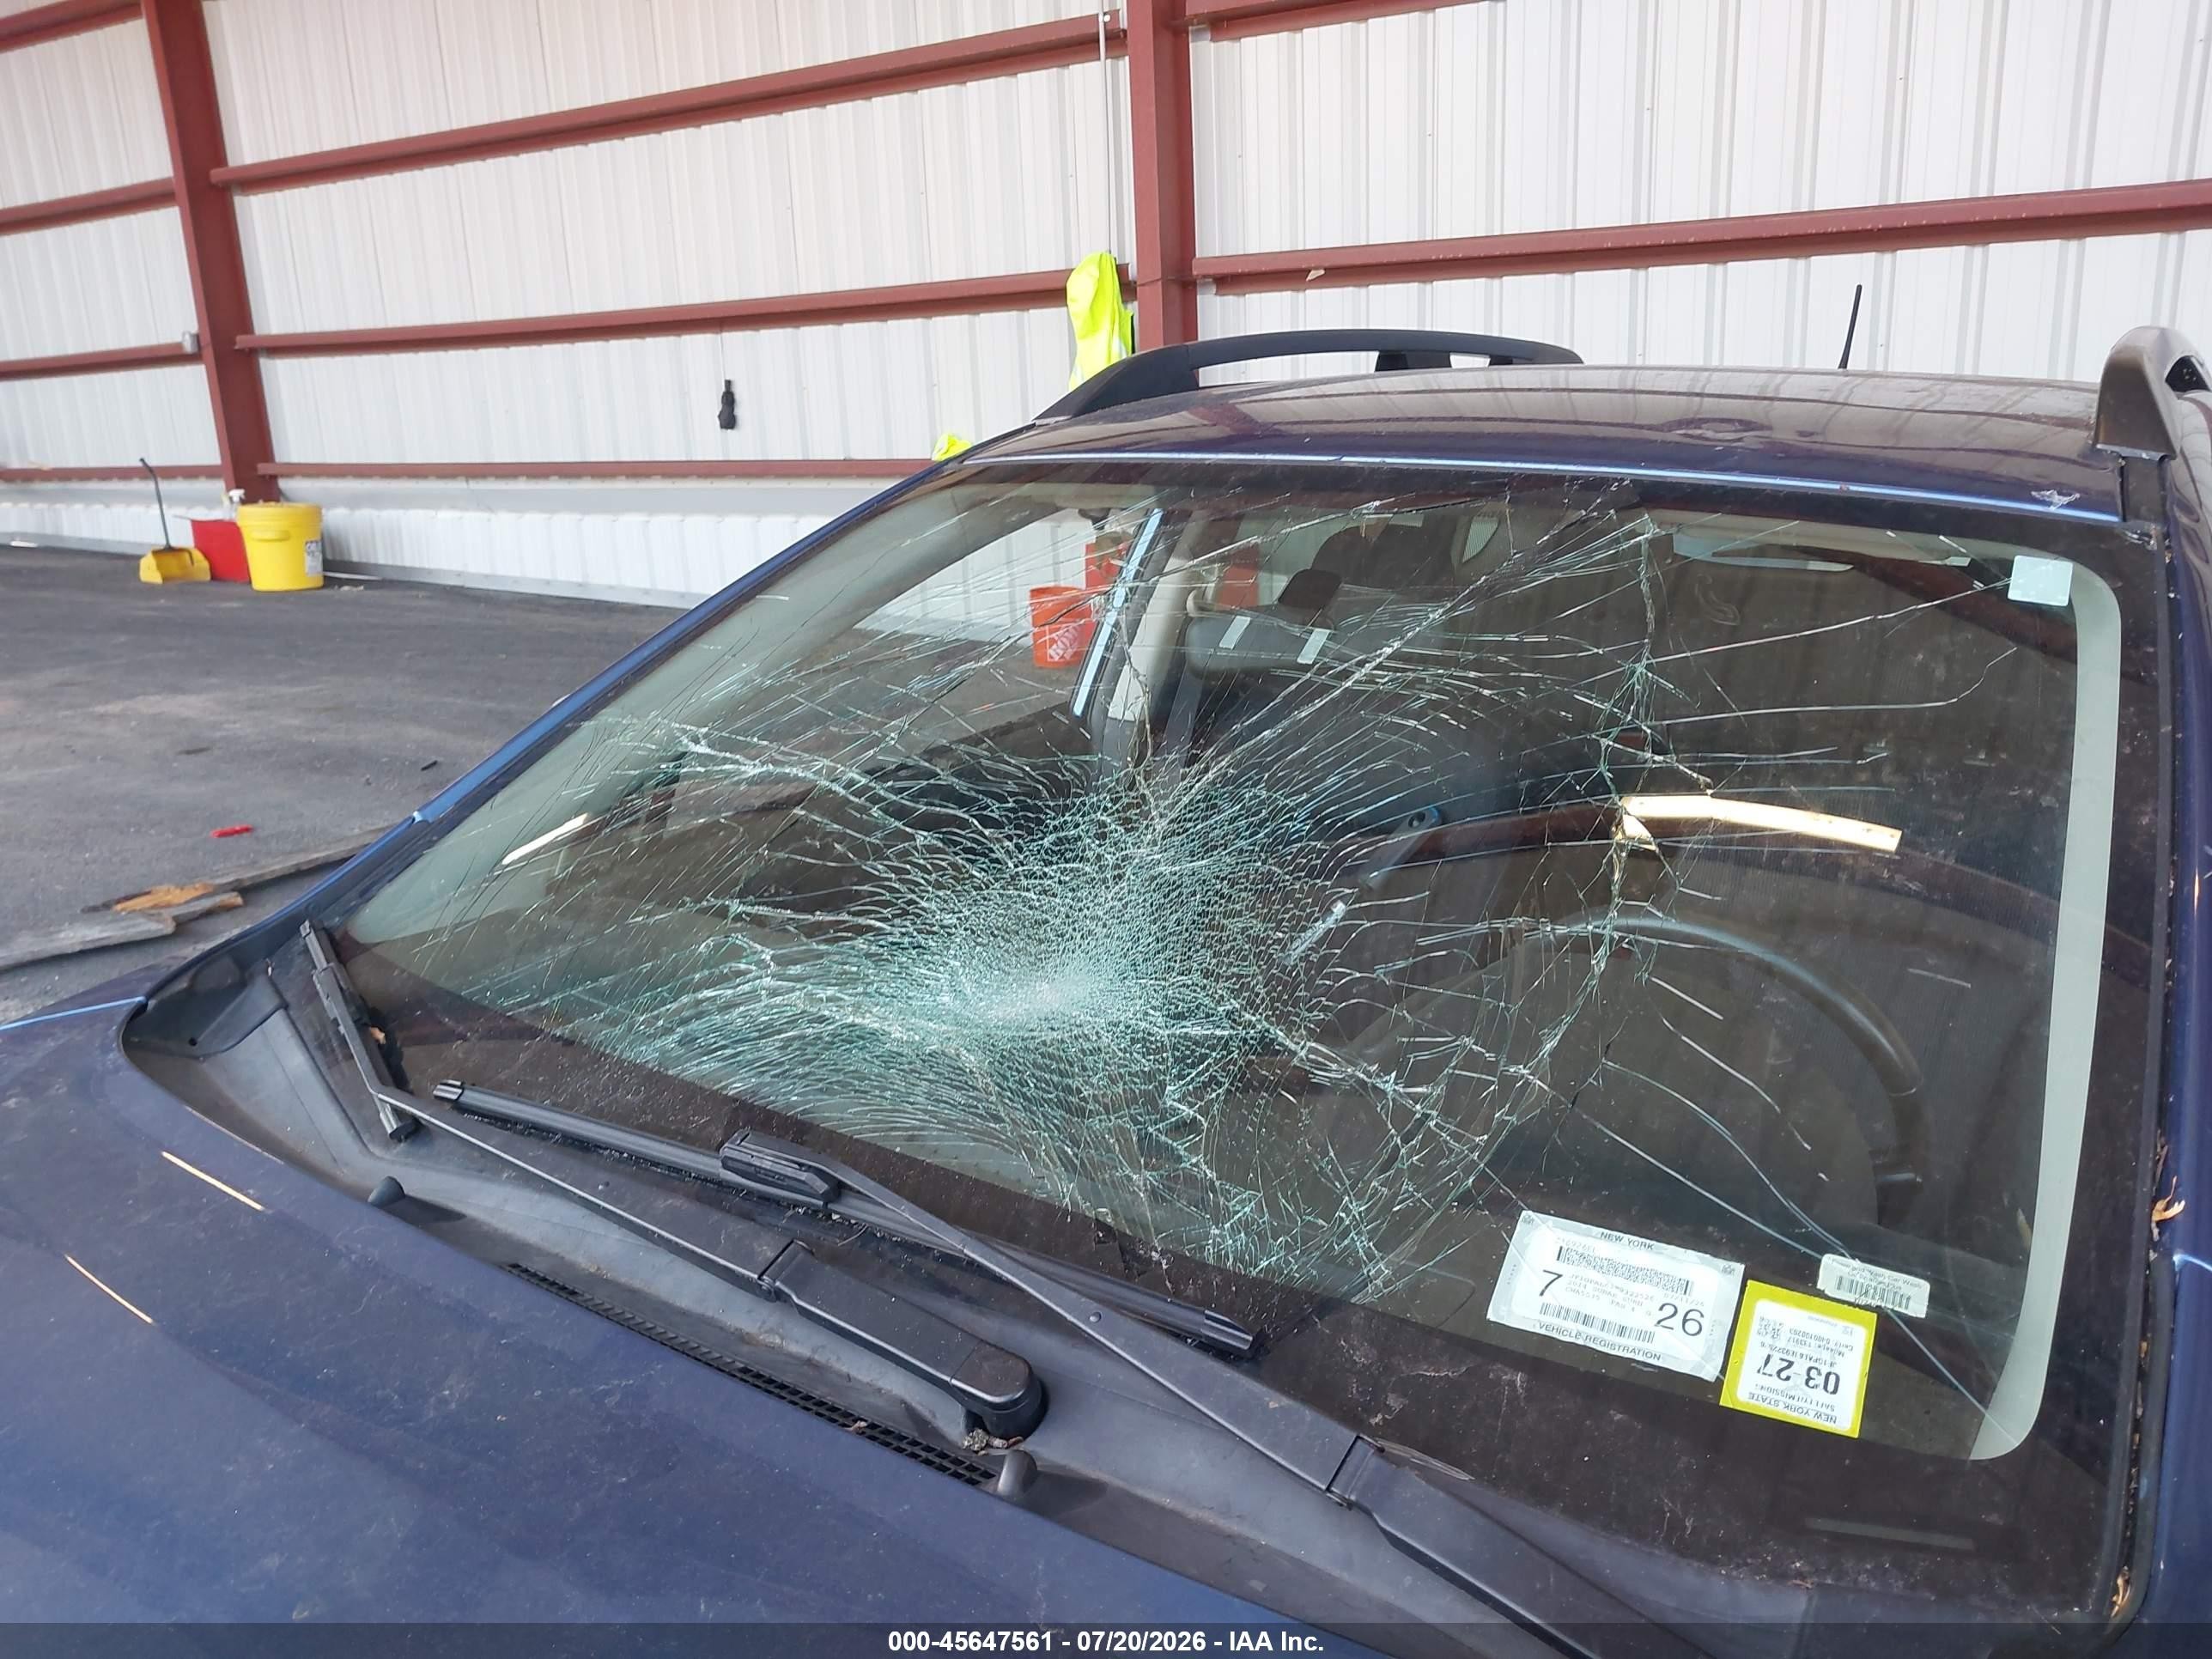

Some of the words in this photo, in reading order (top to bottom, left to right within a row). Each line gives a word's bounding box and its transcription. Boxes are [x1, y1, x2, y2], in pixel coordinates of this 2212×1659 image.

[1600, 1231, 1625, 1243] NEW
[1627, 1237, 1655, 1250] YORK
[1538, 1268, 1564, 1297] 7
[1654, 1302, 1705, 1337] 26
[1537, 1321, 1583, 1341] VEHICLE
[1587, 1334, 1662, 1363] REGISTRATION
[1747, 1391, 1781, 1408] STATE
[1783, 1402, 1812, 1417] YORK
[1813, 1411, 1838, 1425] NEW
